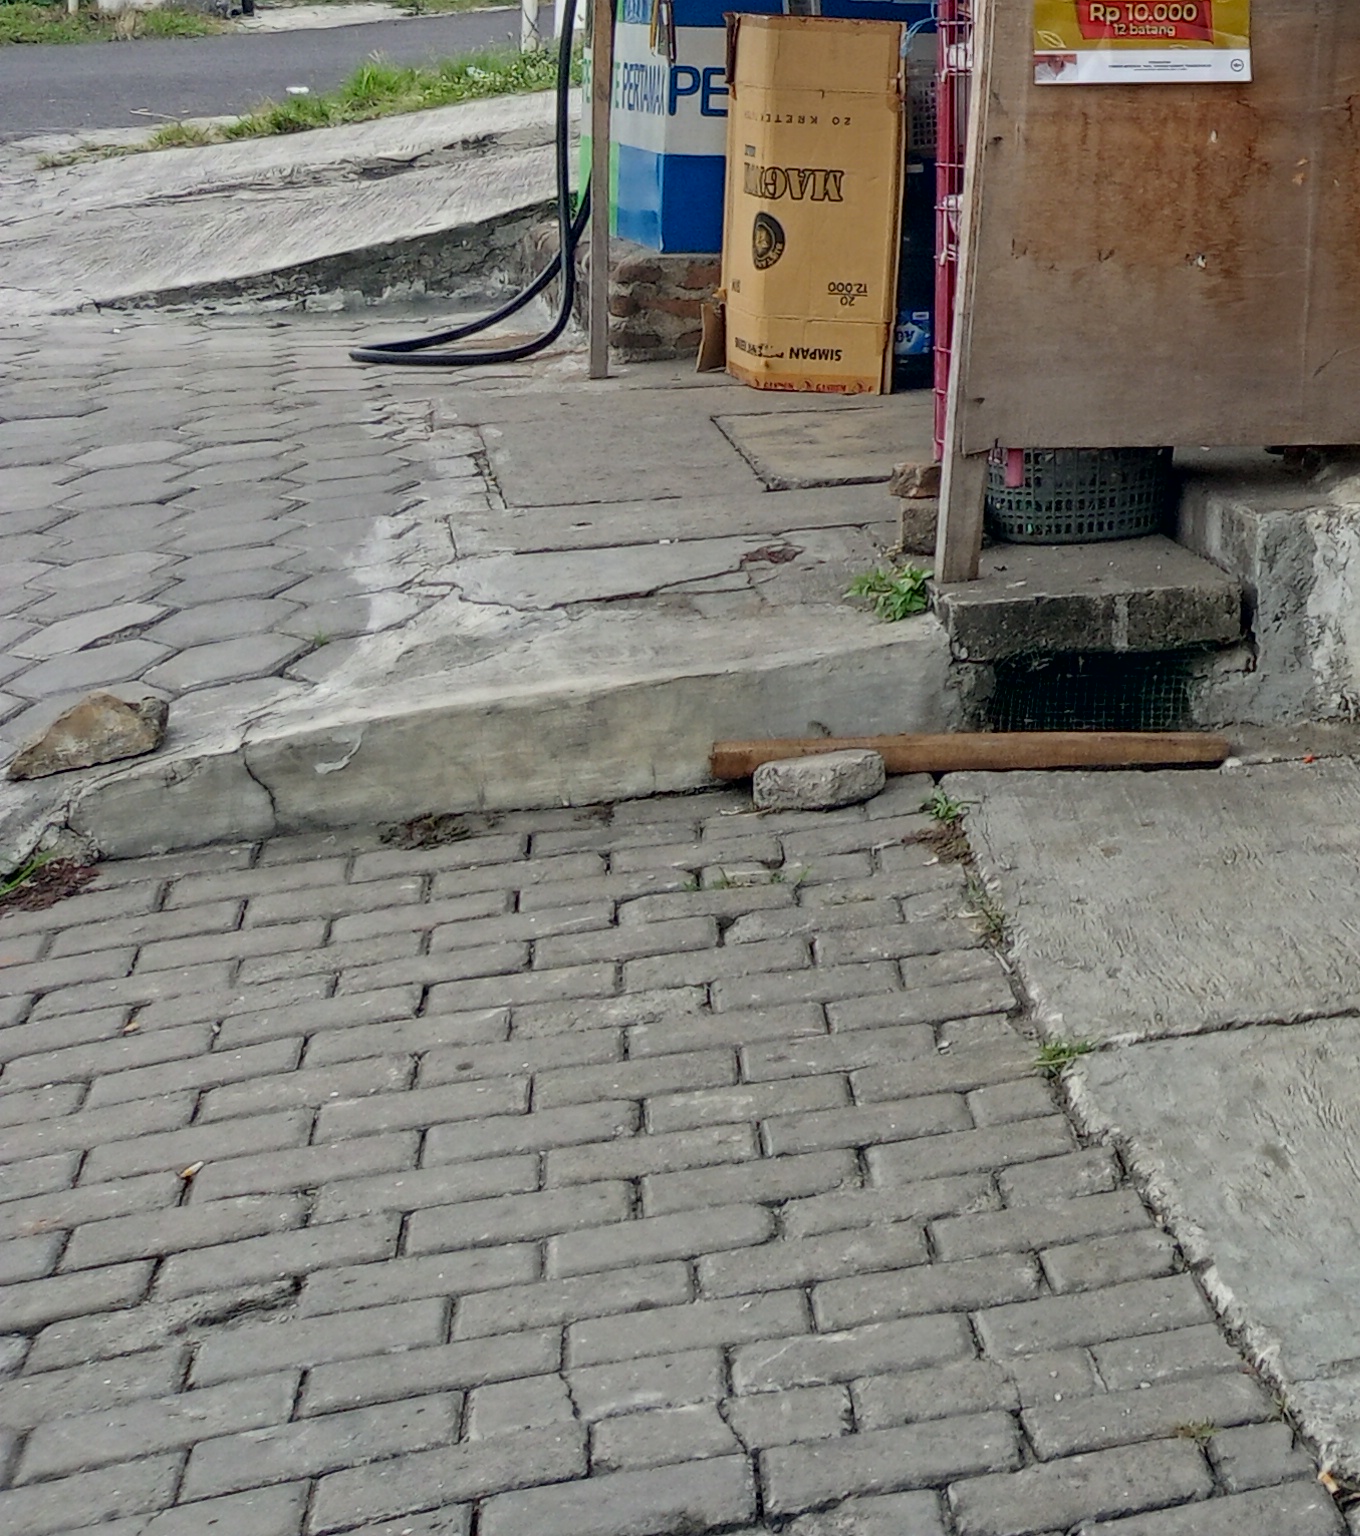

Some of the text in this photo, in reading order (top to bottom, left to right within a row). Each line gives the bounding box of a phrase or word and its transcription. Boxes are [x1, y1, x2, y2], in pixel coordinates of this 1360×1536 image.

[1089, 3, 1198, 24] Rp 10.000
[1114, 23, 1176, 37] 12 batang
[840, 296, 855, 306] 20
[789, 347, 843, 362] SIMPAN
